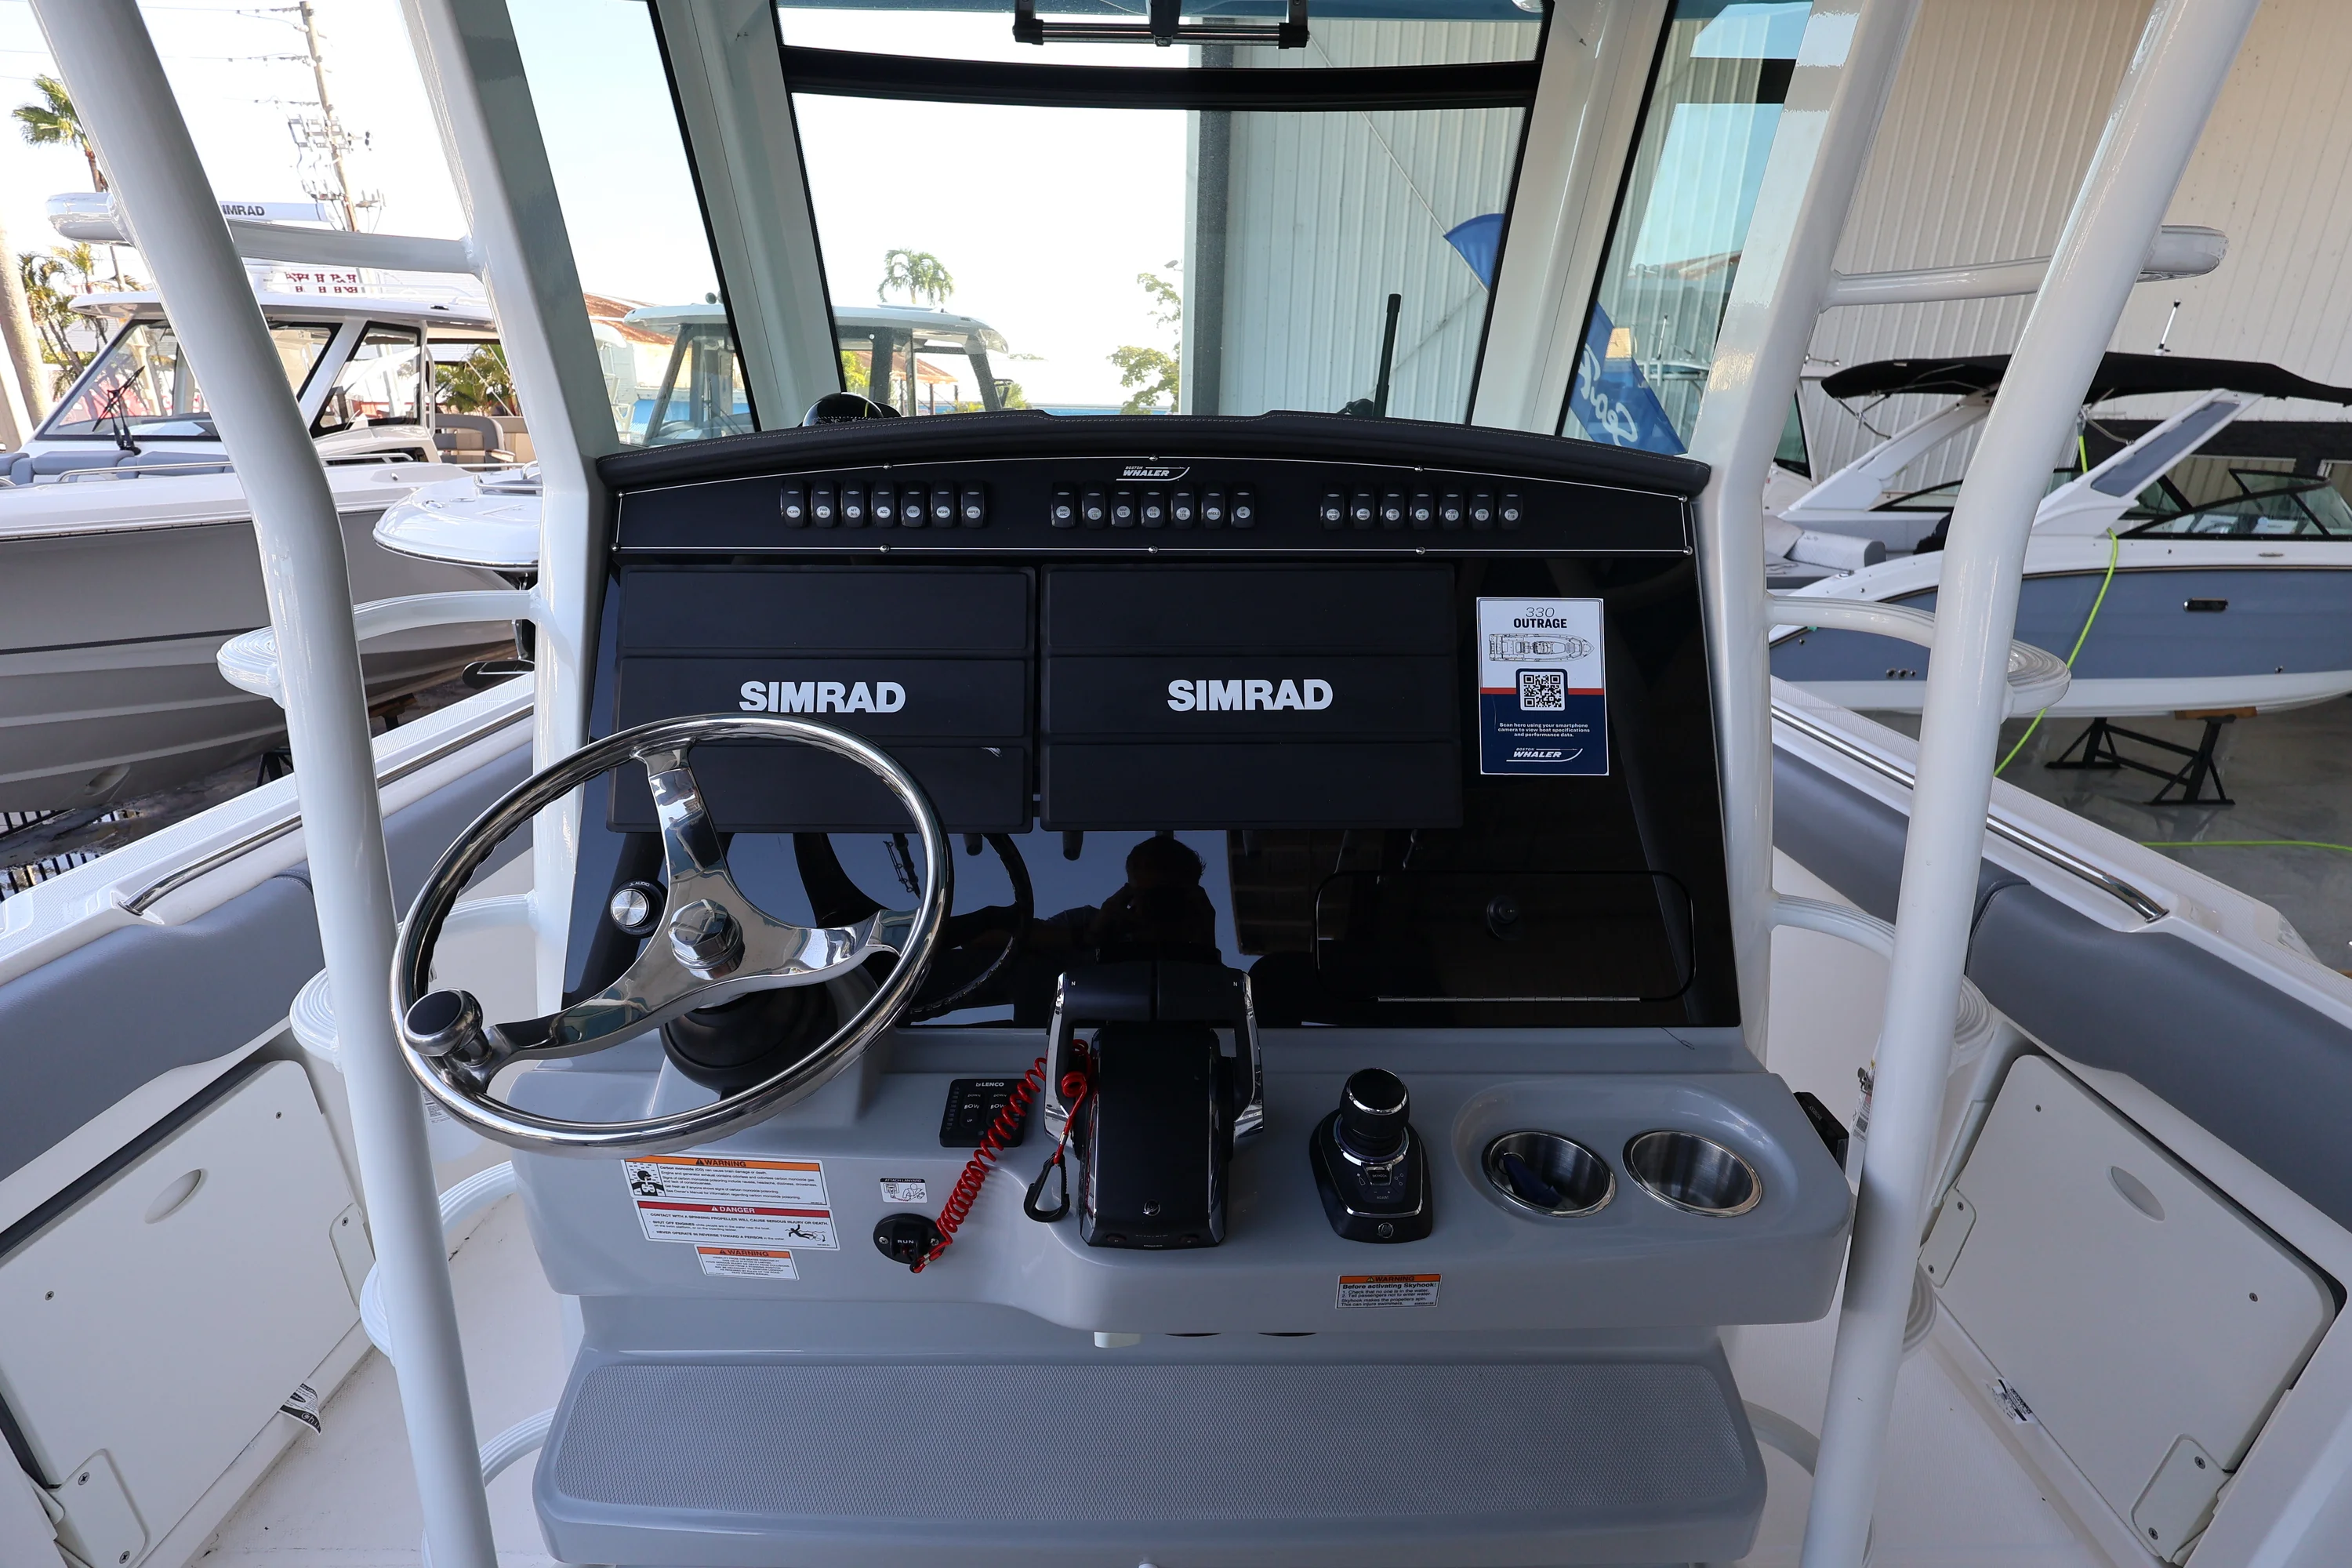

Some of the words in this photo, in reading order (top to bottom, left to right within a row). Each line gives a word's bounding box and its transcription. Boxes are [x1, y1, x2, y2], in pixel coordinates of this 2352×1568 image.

[221, 205, 265, 216] IMRAD
[1526, 607, 1555, 618] 330
[1514, 618, 1568, 629] OUTRAGE
[739, 681, 906, 713] SIMRAD
[1167, 679, 1333, 711] SIMRAD
